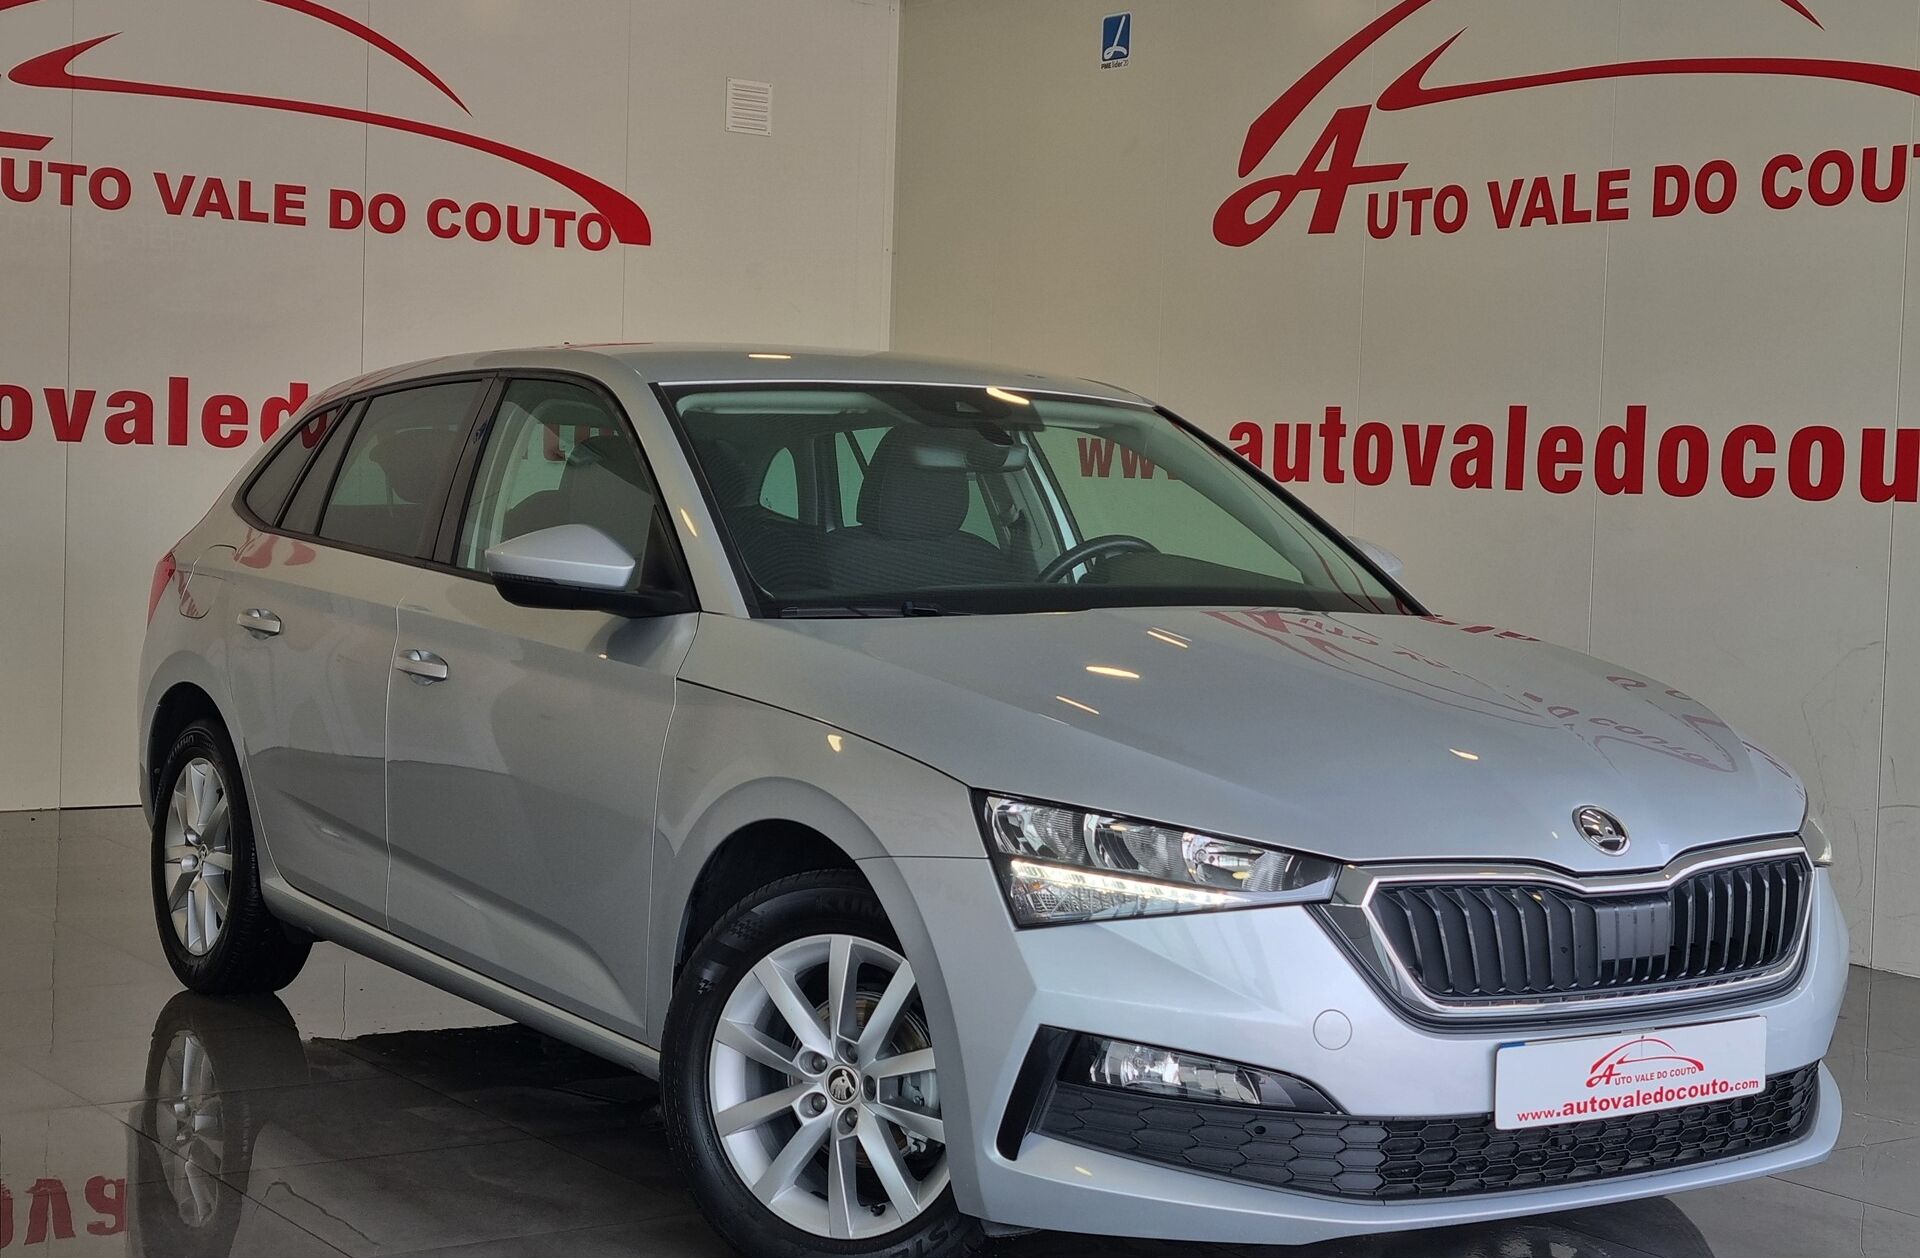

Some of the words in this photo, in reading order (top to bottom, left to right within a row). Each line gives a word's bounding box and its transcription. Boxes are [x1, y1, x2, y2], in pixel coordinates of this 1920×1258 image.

[0, 140, 133, 210] UTO
[154, 172, 307, 226] VALE
[329, 188, 407, 235] DO
[426, 198, 613, 254] COUTO
[1212, 104, 1469, 247] AUTO
[1488, 168, 1631, 229] VALE
[1653, 160, 1739, 217] DO
[1517, 1078, 1760, 1122] www.autovaledocouto.com
[1585, 1063, 1633, 1088] AUTO
[1634, 1072, 1655, 1083] VALE
[1656, 1070, 1668, 1080] DO
[1669, 1065, 1697, 1078] COUTO
